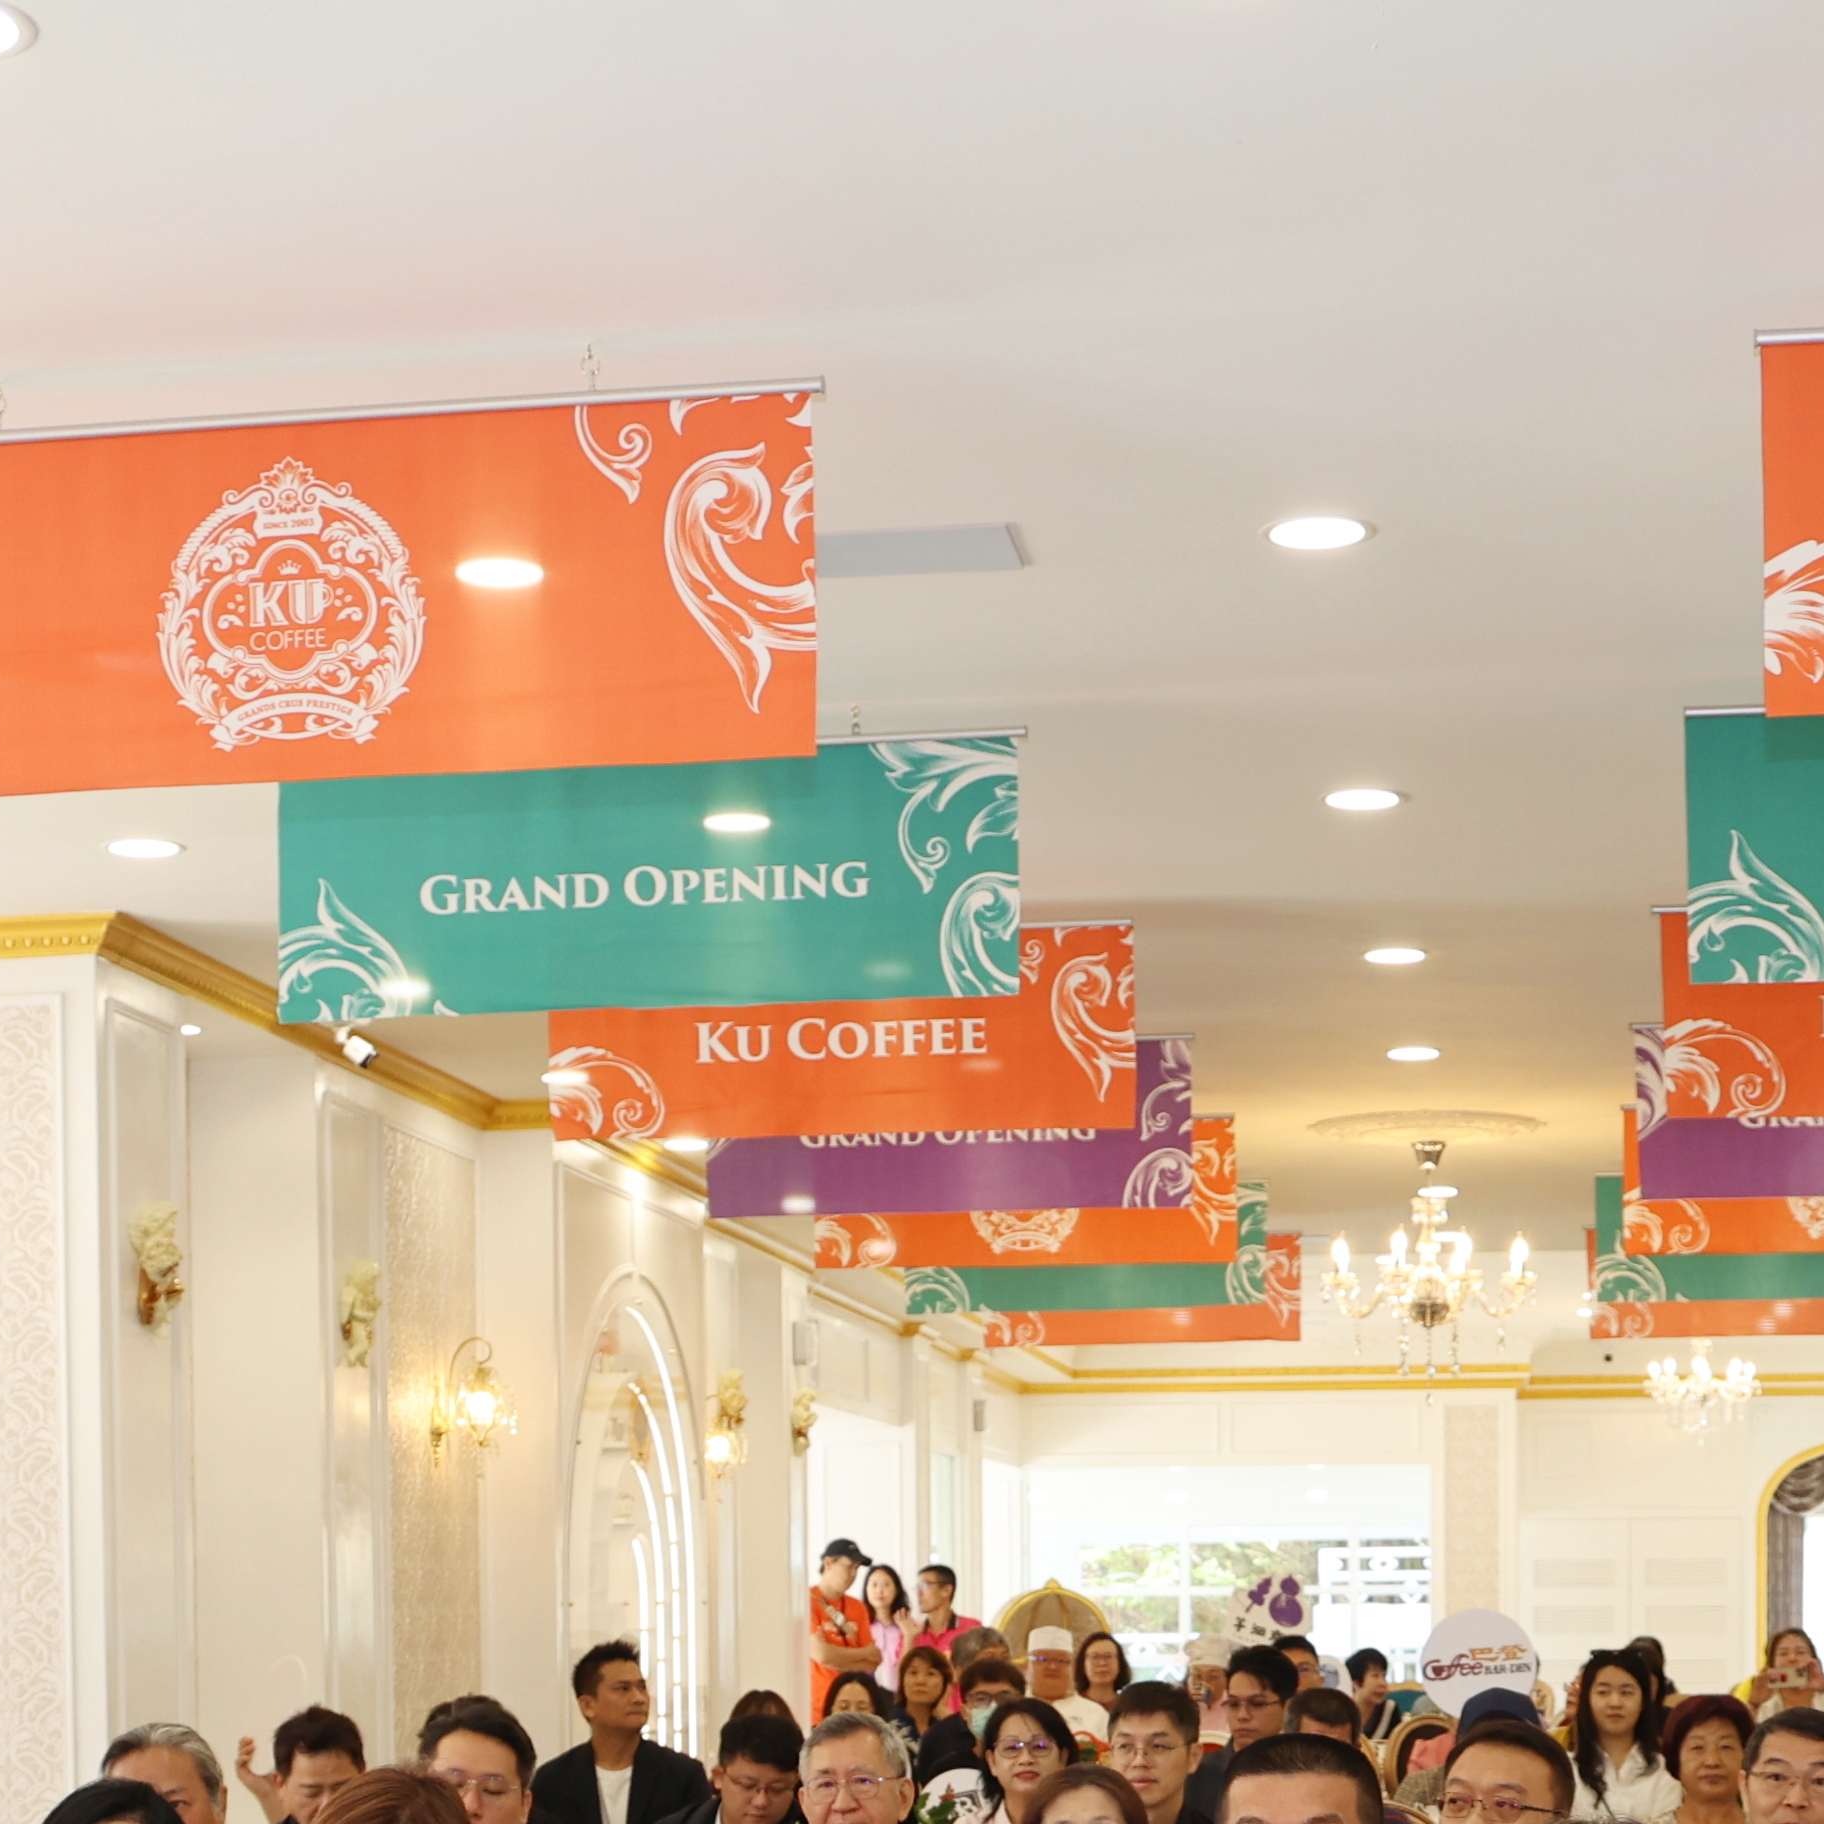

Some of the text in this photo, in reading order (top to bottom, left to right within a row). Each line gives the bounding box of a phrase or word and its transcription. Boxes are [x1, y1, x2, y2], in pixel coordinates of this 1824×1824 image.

[249, 628, 327, 652] COFFEE
[419, 861, 871, 916] GRAND OPENING
[786, 1017, 988, 1061] COFFEE
